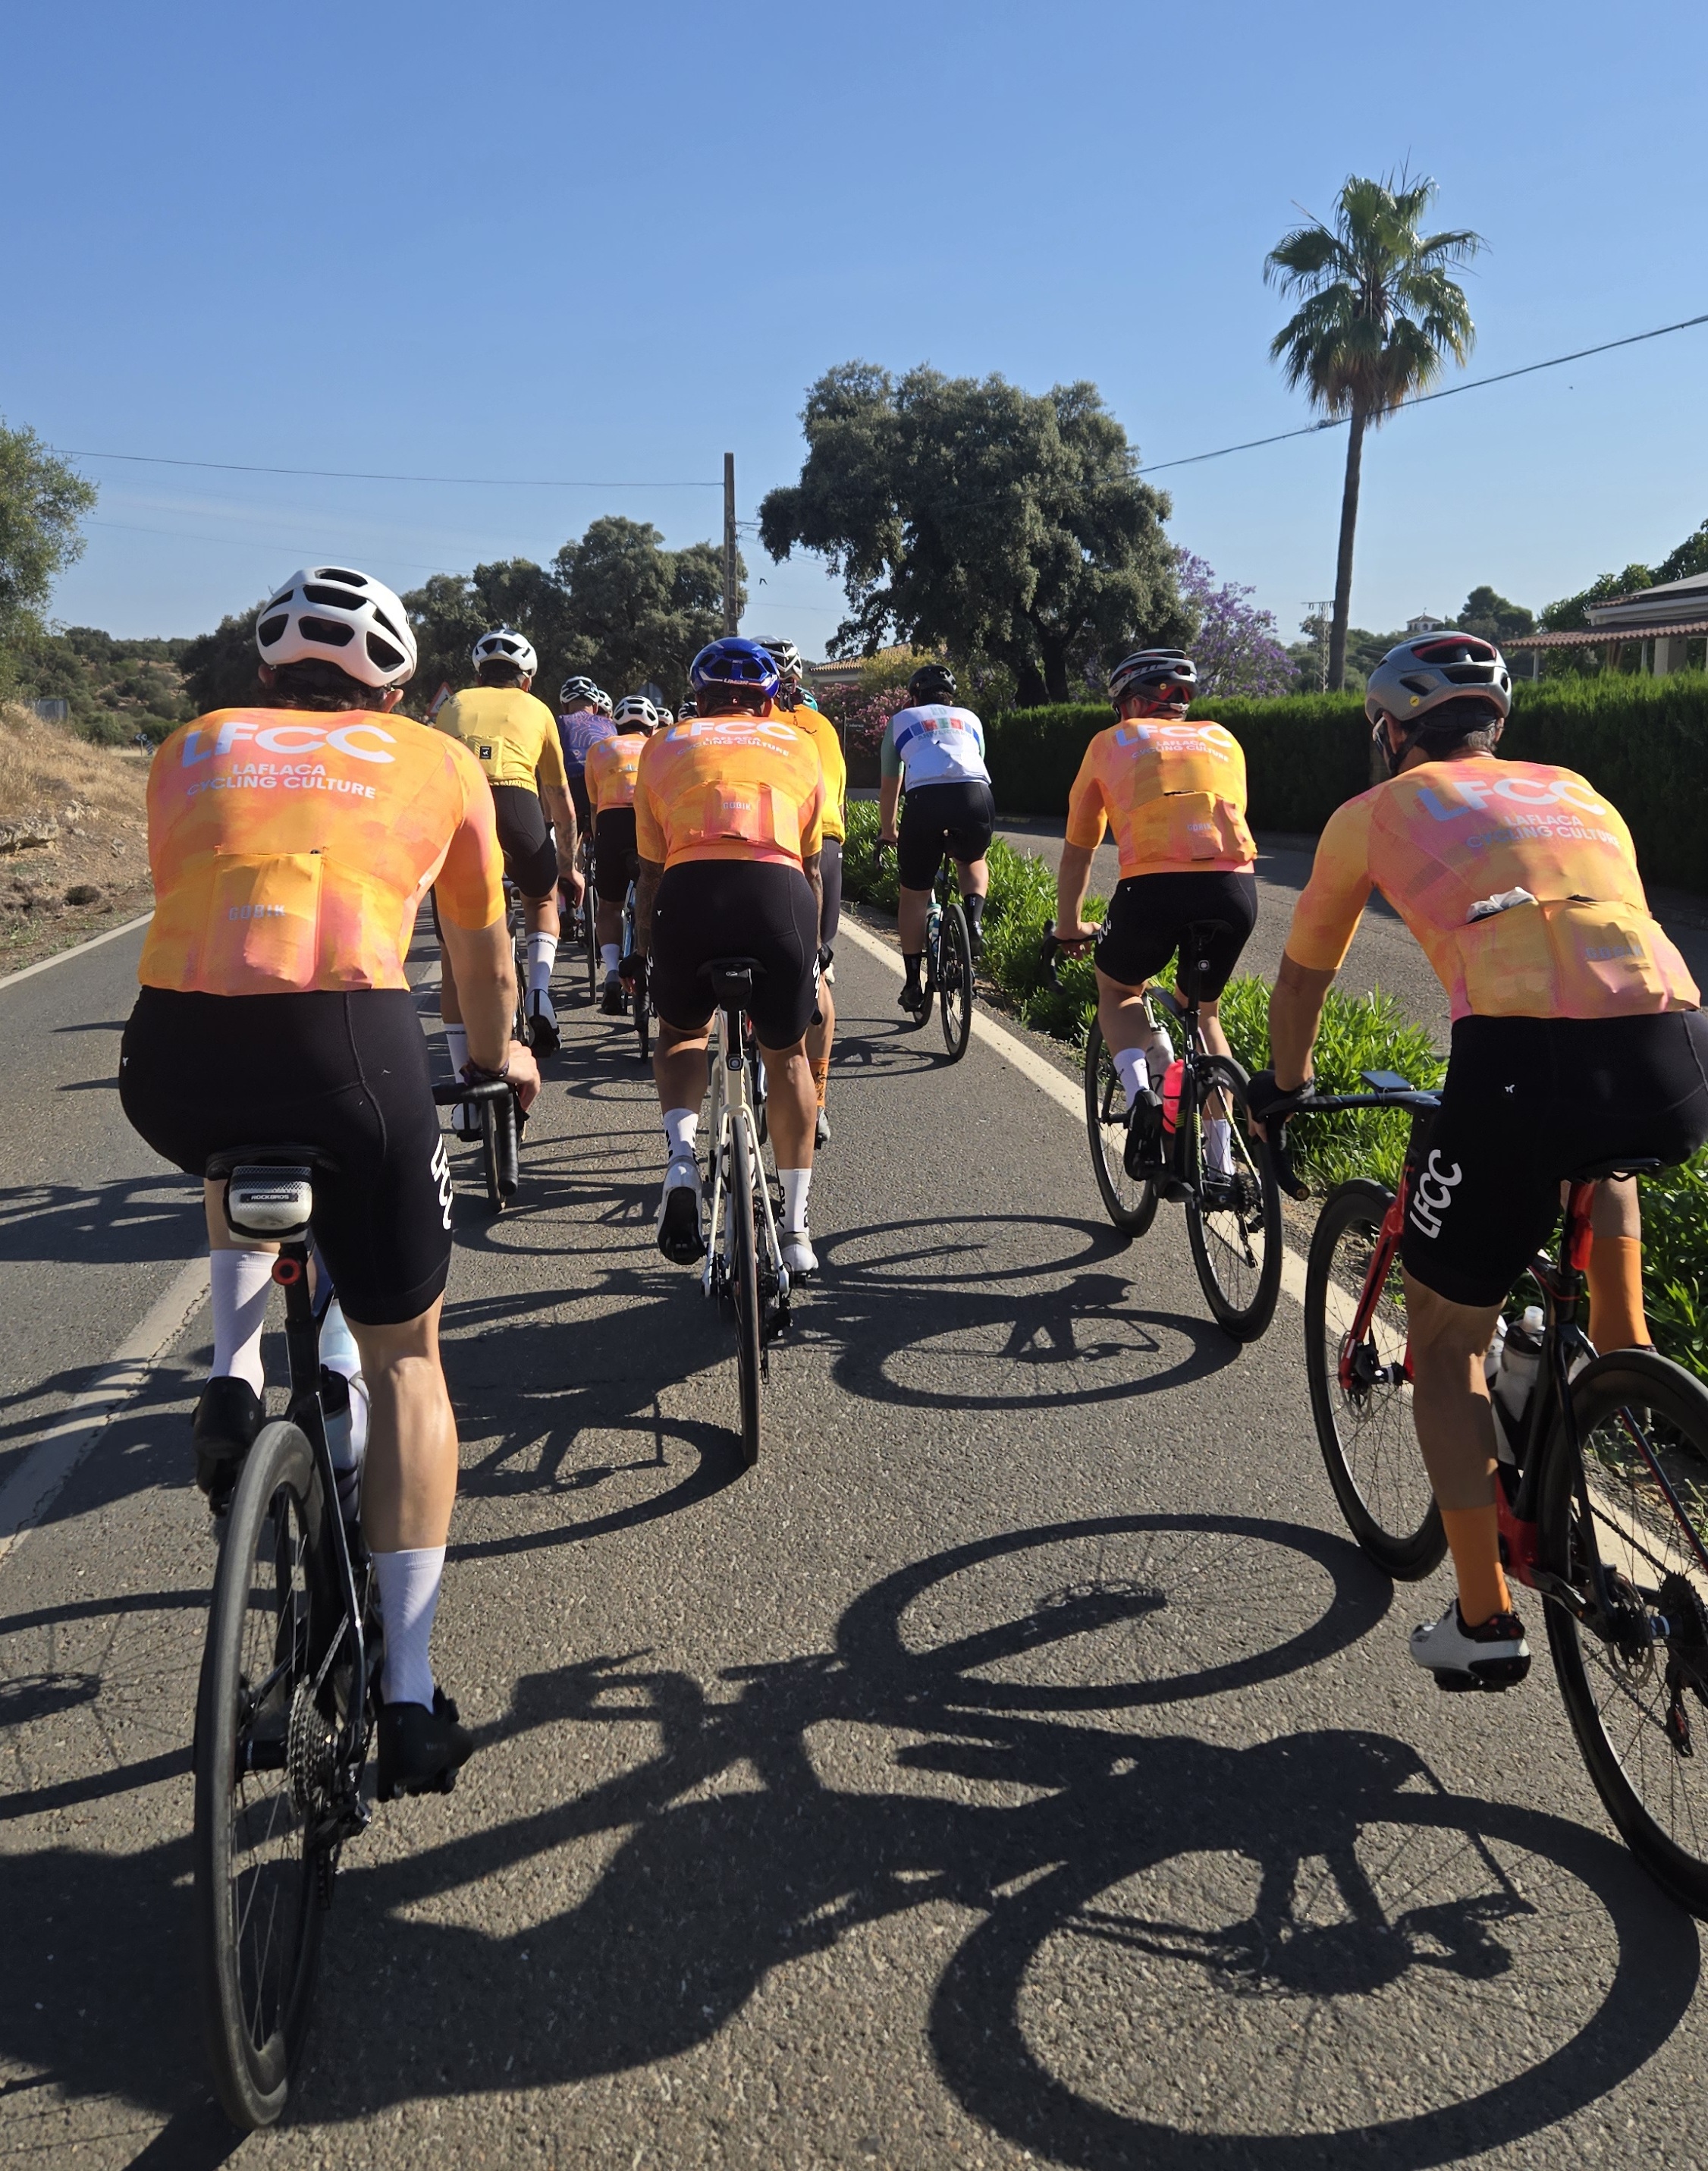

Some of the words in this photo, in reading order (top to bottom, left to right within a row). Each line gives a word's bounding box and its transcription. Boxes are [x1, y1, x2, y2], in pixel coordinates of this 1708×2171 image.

[665, 721, 799, 743] LFCC
[1115, 724, 1232, 748] LFCC
[182, 722, 397, 768] LFCC
[599, 740, 646, 753] LFC
[736, 740, 790, 757] CULTURE
[1186, 745, 1229, 762] CULTURE
[232, 764, 326, 776] LAFLACA
[187, 776, 278, 796] CYCLING
[284, 777, 376, 800] CULTURE
[1416, 778, 1606, 822] LFCC
[1505, 815, 1584, 827] LAFLACA
[1466, 825, 1553, 847] CYCLING
[1557, 826, 1622, 849] CULTURE
[1410, 1149, 1462, 1239] LFCC
